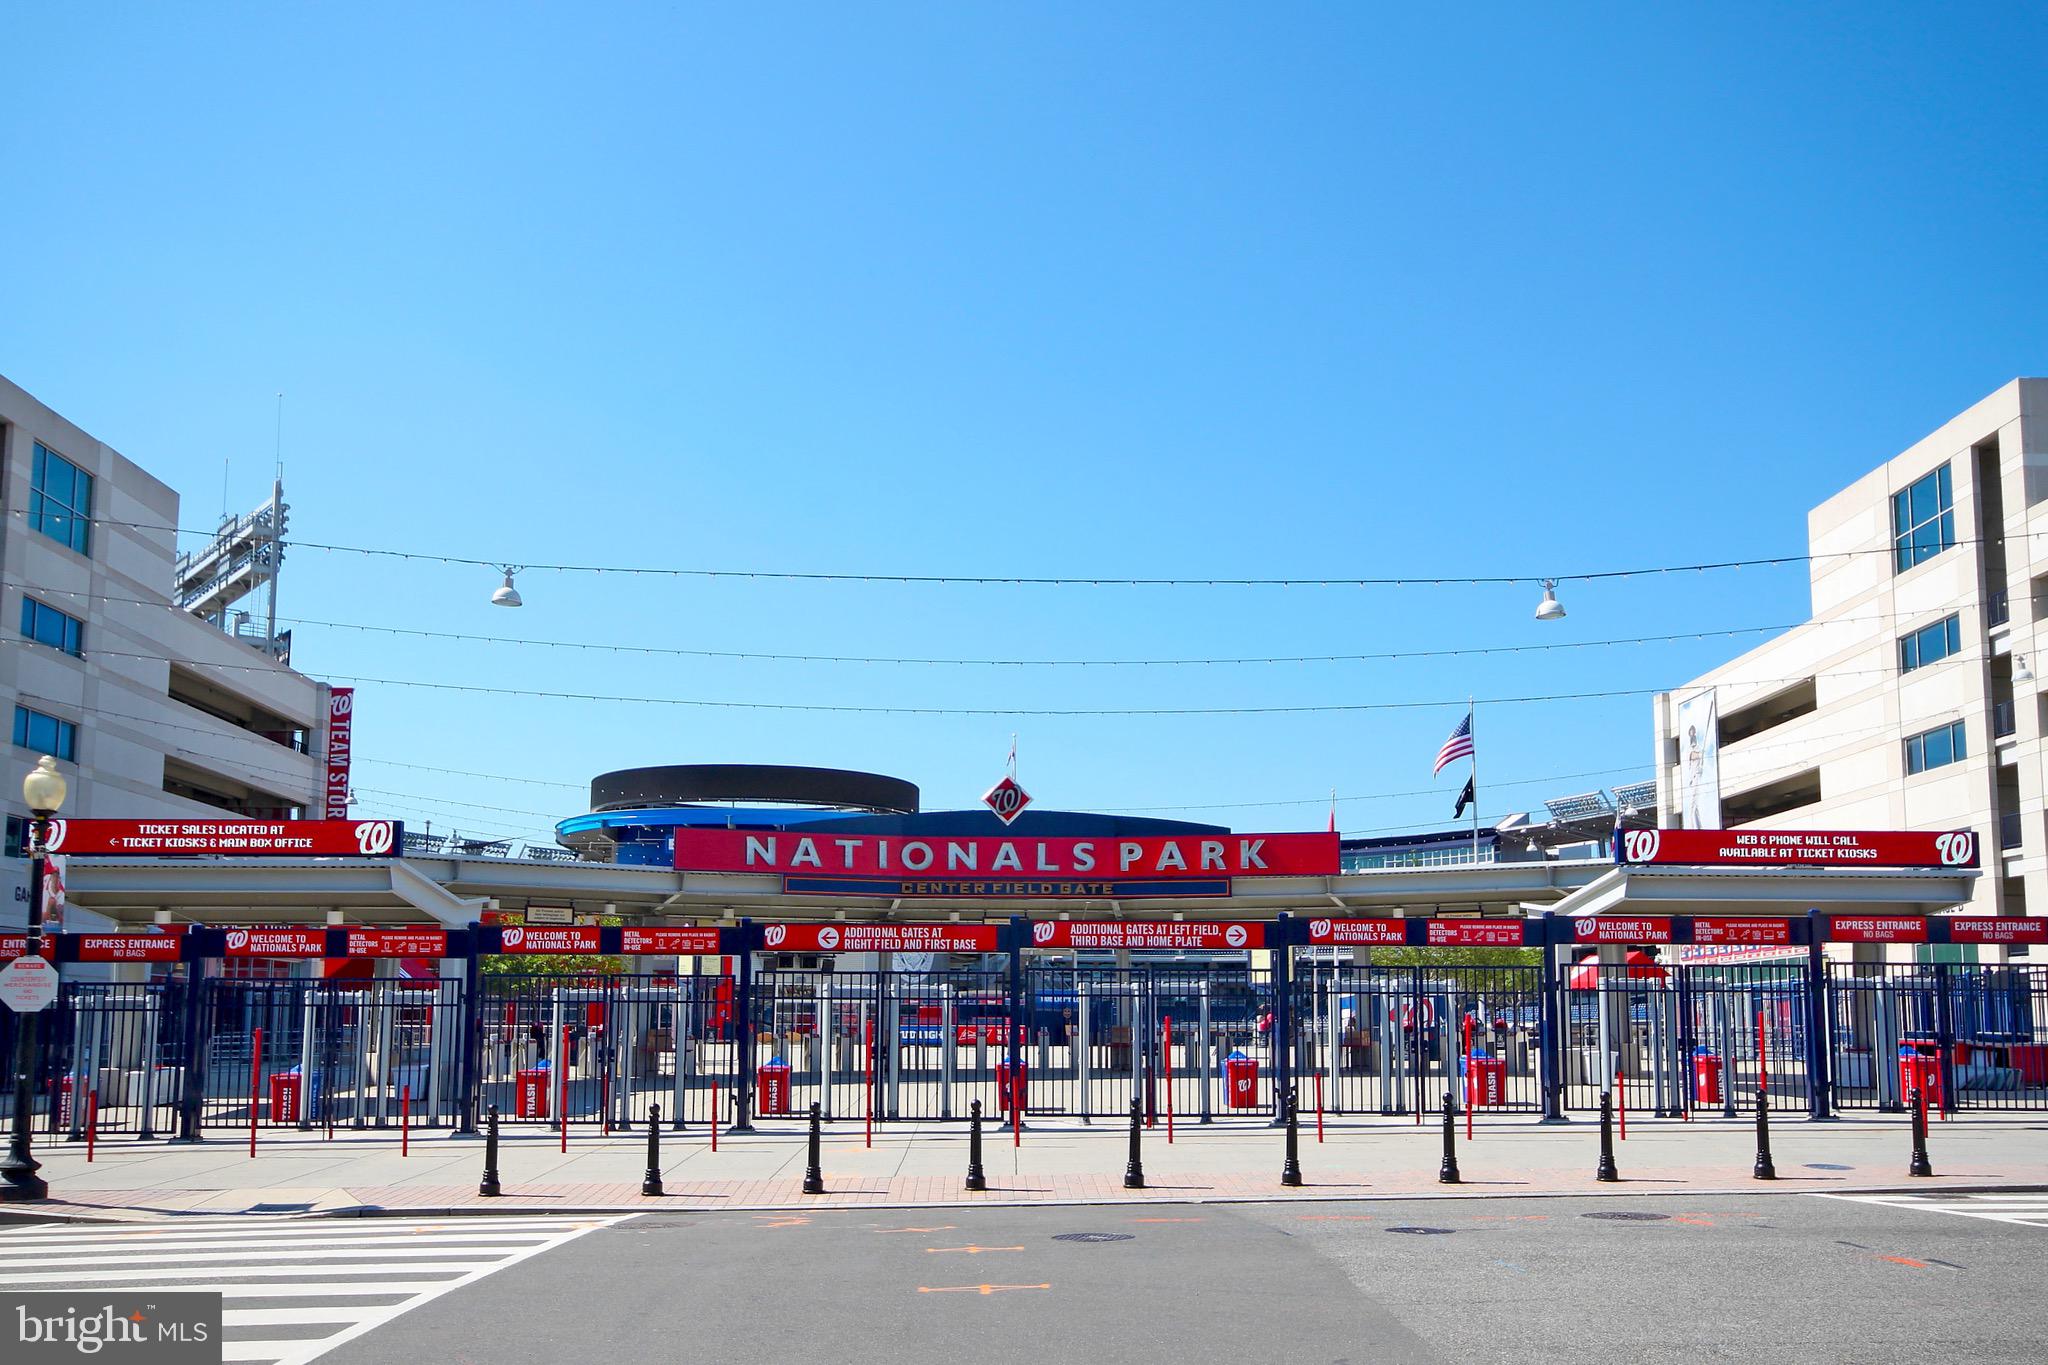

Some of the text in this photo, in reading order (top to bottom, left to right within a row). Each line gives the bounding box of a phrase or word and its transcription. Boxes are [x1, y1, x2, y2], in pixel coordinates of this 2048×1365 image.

[328, 720, 350, 818] TEAM STOR
[138, 825, 285, 835] TICKET SALES LOCATED AT
[122, 838, 313, 848] TICKET KIOSKS & MAIN BOX OFFICE
[1736, 836, 1859, 846] WEB & PHONE WILL CALL
[746, 835, 1269, 872] NATIONALS PARK
[1719, 848, 1878, 858] AVAILABLE AT TICKET KIOSKS
[901, 883, 1113, 894] CENTER FIELD GATE
[1070, 924, 1222, 936] ADDITIONAL GATES AT LEFT FIELD,
[1334, 924, 1387, 932] WELCOME TO
[1599, 923, 1652, 931] WELCOME TO
[1836, 921, 1921, 930] EXPRESS ENTRANCE
[1955, 922, 2041, 931] EXPRESS ENTRANCE
[526, 931, 581, 940] WELCOME TO
[844, 927, 943, 938] ADDITIONAL GATES AT
[1333, 932, 1402, 941] NATIONALS PARK
[1599, 931, 1668, 940] NATIONALS PARK
[85, 939, 175, 949] EXPRESS ENTRANCE
[251, 935, 306, 943] WELCOME TO
[844, 939, 977, 949] RIGHT FIELD AND FIRST BASE
[1070, 936, 1203, 946] THIRD BASE AND HOME PLATE
[251, 943, 322, 953] NATIONALS PARK
[526, 940, 596, 949] NATIONALS PARK
[113, 950, 146, 958] NO BAGS
[1488, 1072, 1497, 1104] TRASH
[527, 1084, 536, 1116] TRASH
